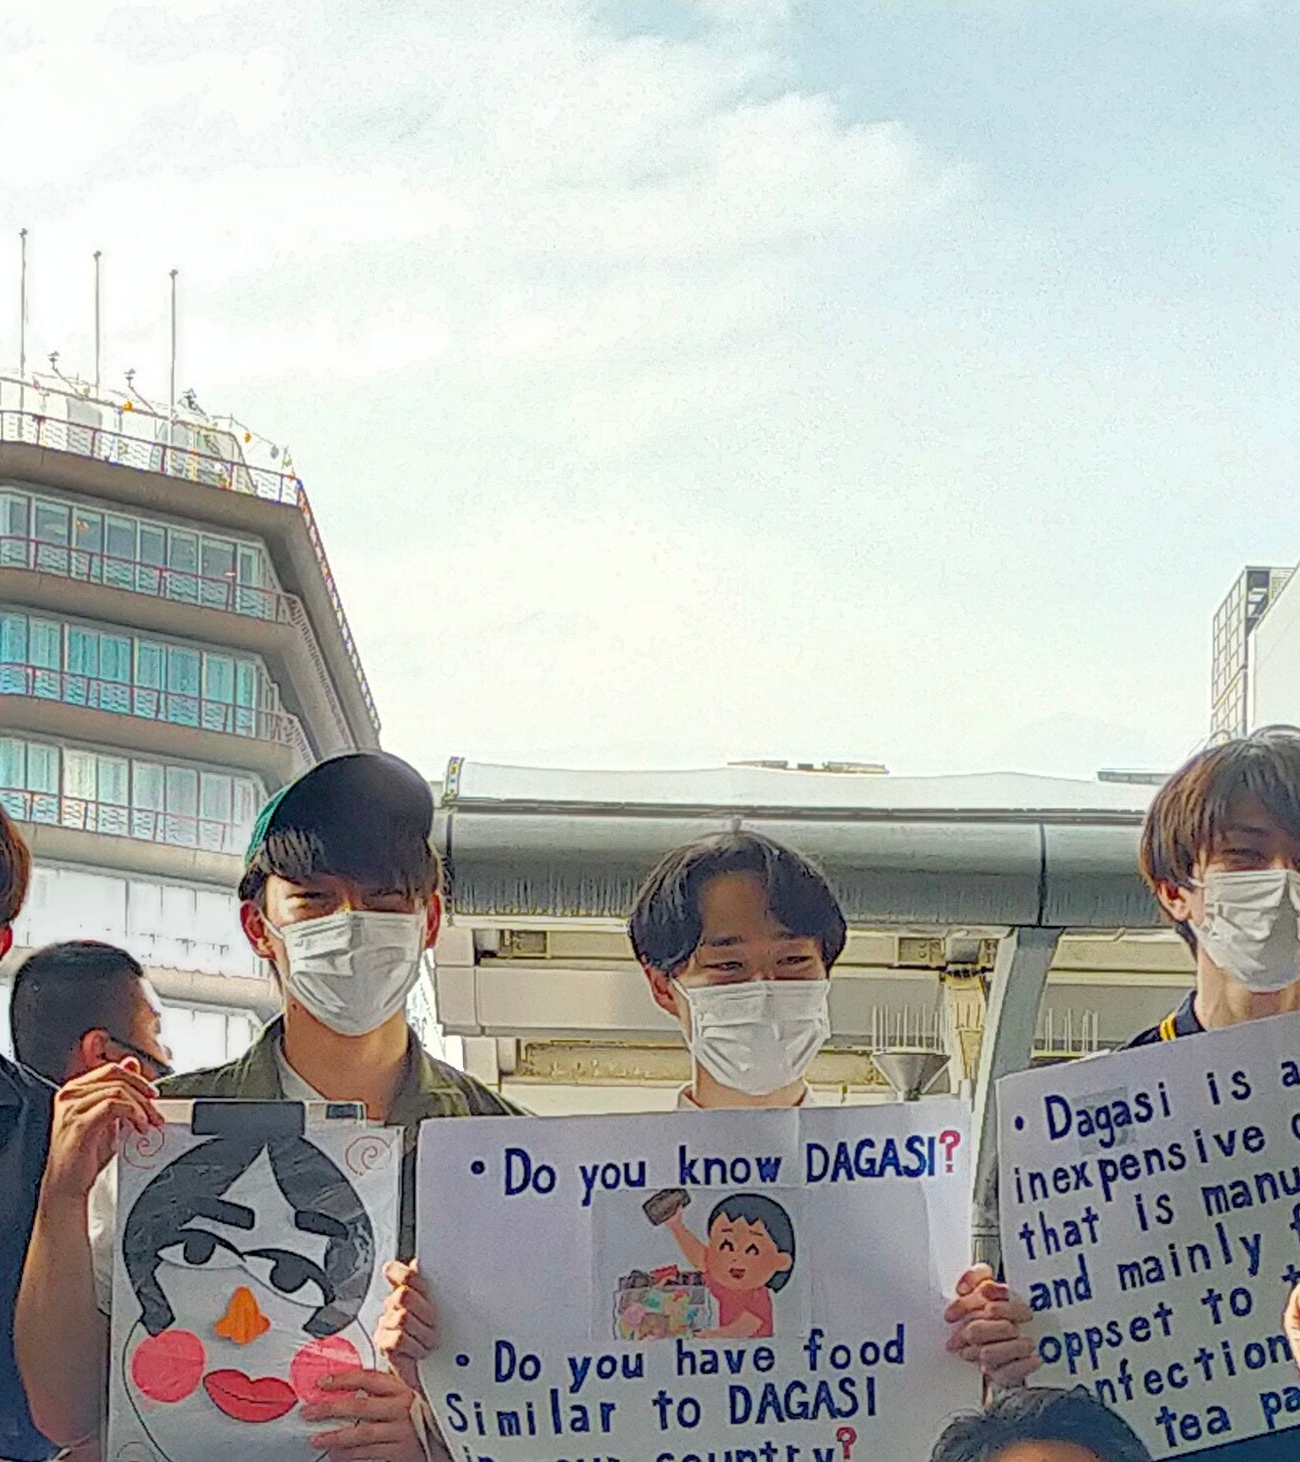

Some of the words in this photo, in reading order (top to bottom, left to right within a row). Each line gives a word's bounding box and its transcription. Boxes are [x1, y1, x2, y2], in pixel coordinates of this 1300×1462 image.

[1044, 1082, 1171, 1149] Dagasi
[1207, 1070, 1252, 1105] is
[505, 1148, 556, 1195] Do
[580, 1157, 646, 1206] you
[679, 1146, 781, 1184] know
[806, 1129, 960, 1183] DAGASI?
[1014, 1125, 1265, 1203] inexpensive
[1018, 1205, 1099, 1260] that
[1134, 1193, 1174, 1231] is
[1030, 1254, 1092, 1312] and
[1117, 1222, 1261, 1291] mainly
[494, 1341, 540, 1383] Do
[569, 1352, 644, 1393] you
[676, 1342, 774, 1376] have
[805, 1324, 905, 1371] food
[1039, 1302, 1172, 1375] oppset
[1202, 1286, 1252, 1325] to
[446, 1389, 615, 1436] Similar
[654, 1390, 700, 1429] to
[730, 1377, 876, 1425] DAGASI
[1156, 1405, 1232, 1448] tea
